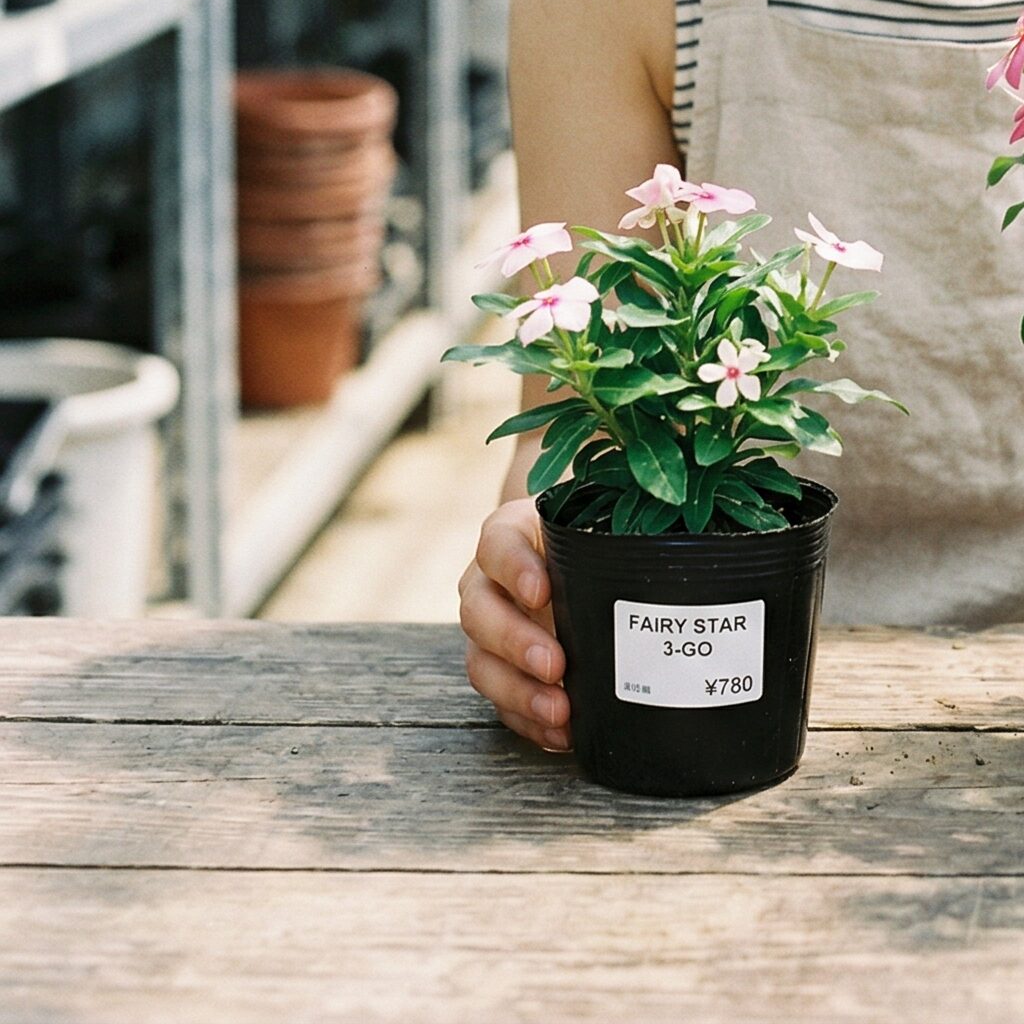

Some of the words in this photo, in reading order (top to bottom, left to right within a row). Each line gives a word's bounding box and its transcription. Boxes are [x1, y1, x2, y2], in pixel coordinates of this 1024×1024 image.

[629, 614, 686, 634] FAIRY
[693, 615, 747, 634] STAR
[663, 640, 713, 657] 3-GO
[705, 675, 753, 696] ¥780
